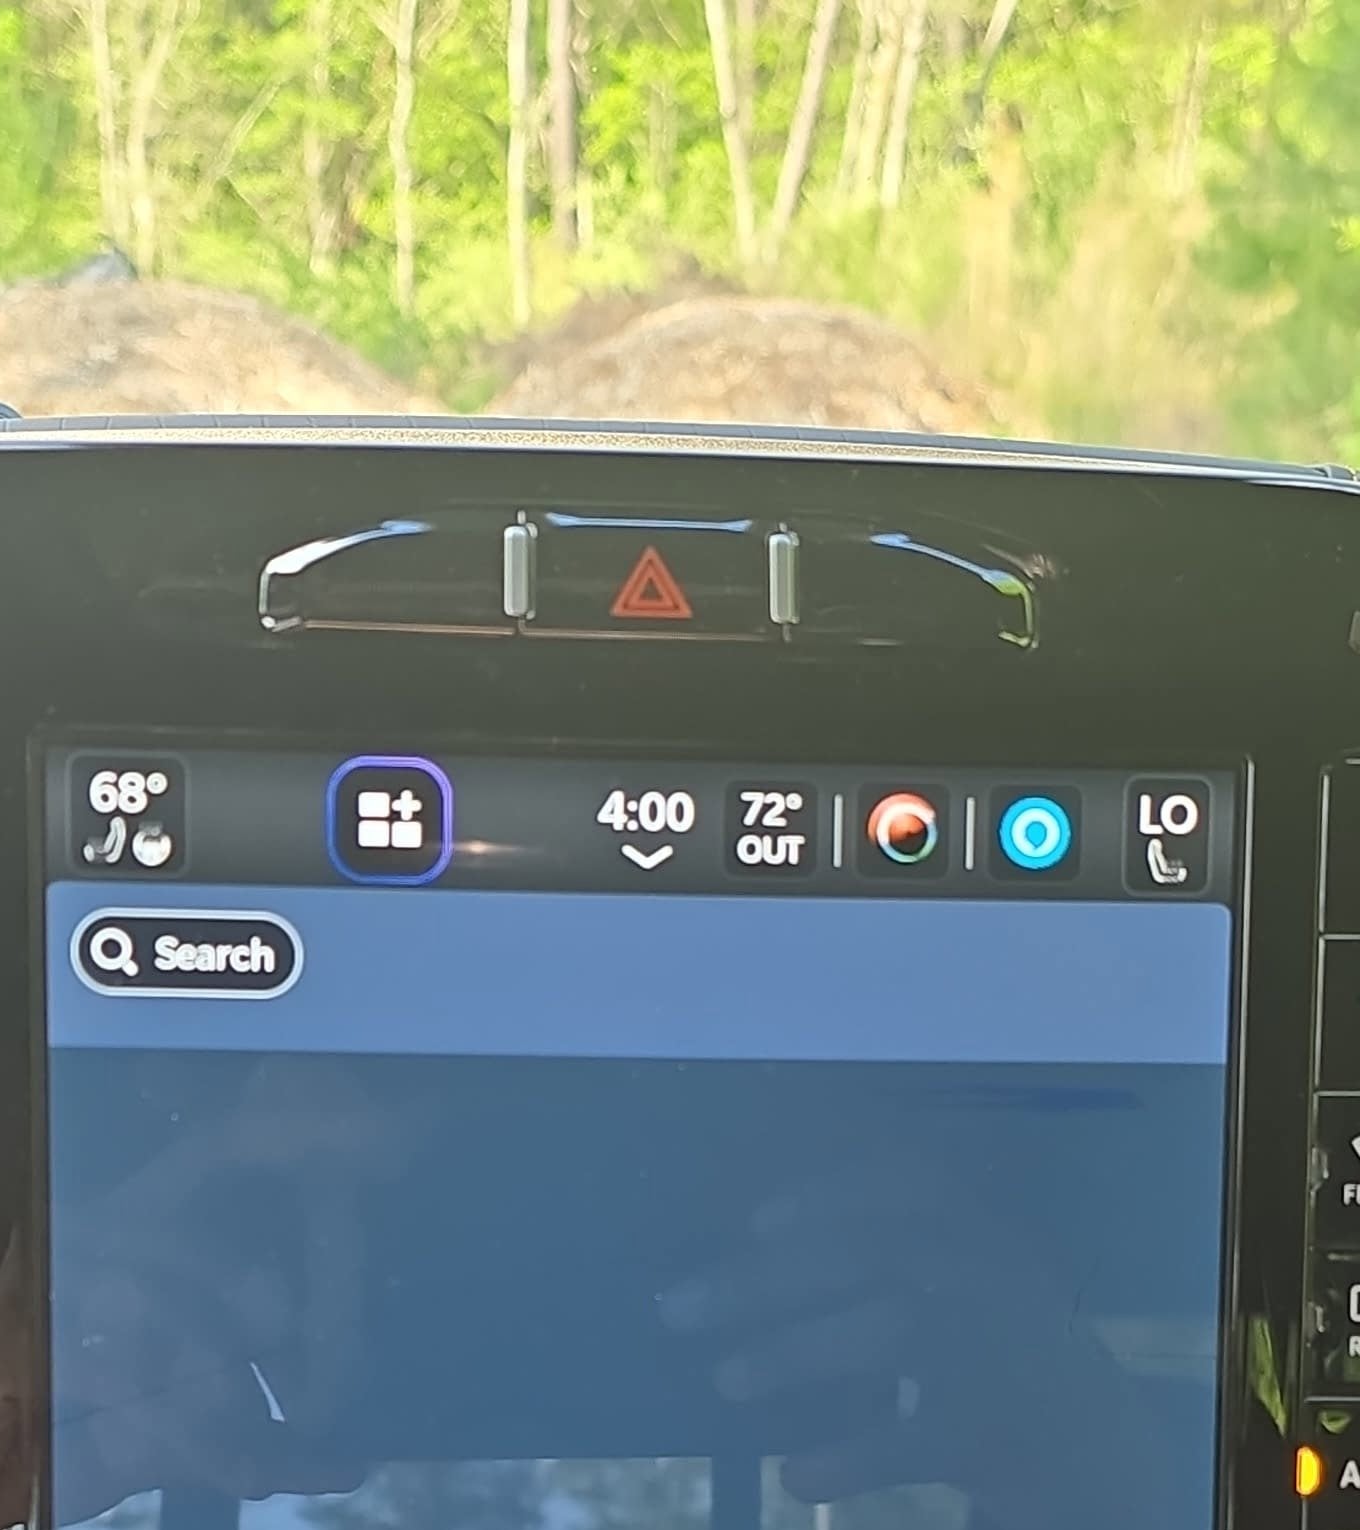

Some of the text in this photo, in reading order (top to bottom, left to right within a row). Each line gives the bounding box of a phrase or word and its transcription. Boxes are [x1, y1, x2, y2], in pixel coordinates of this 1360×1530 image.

[89, 770, 168, 814] 68°
[740, 792, 803, 827] 72°
[597, 791, 695, 834] 4:00
[1139, 794, 1199, 835] LO
[736, 834, 806, 866] OUT
[154, 935, 276, 973] Search
